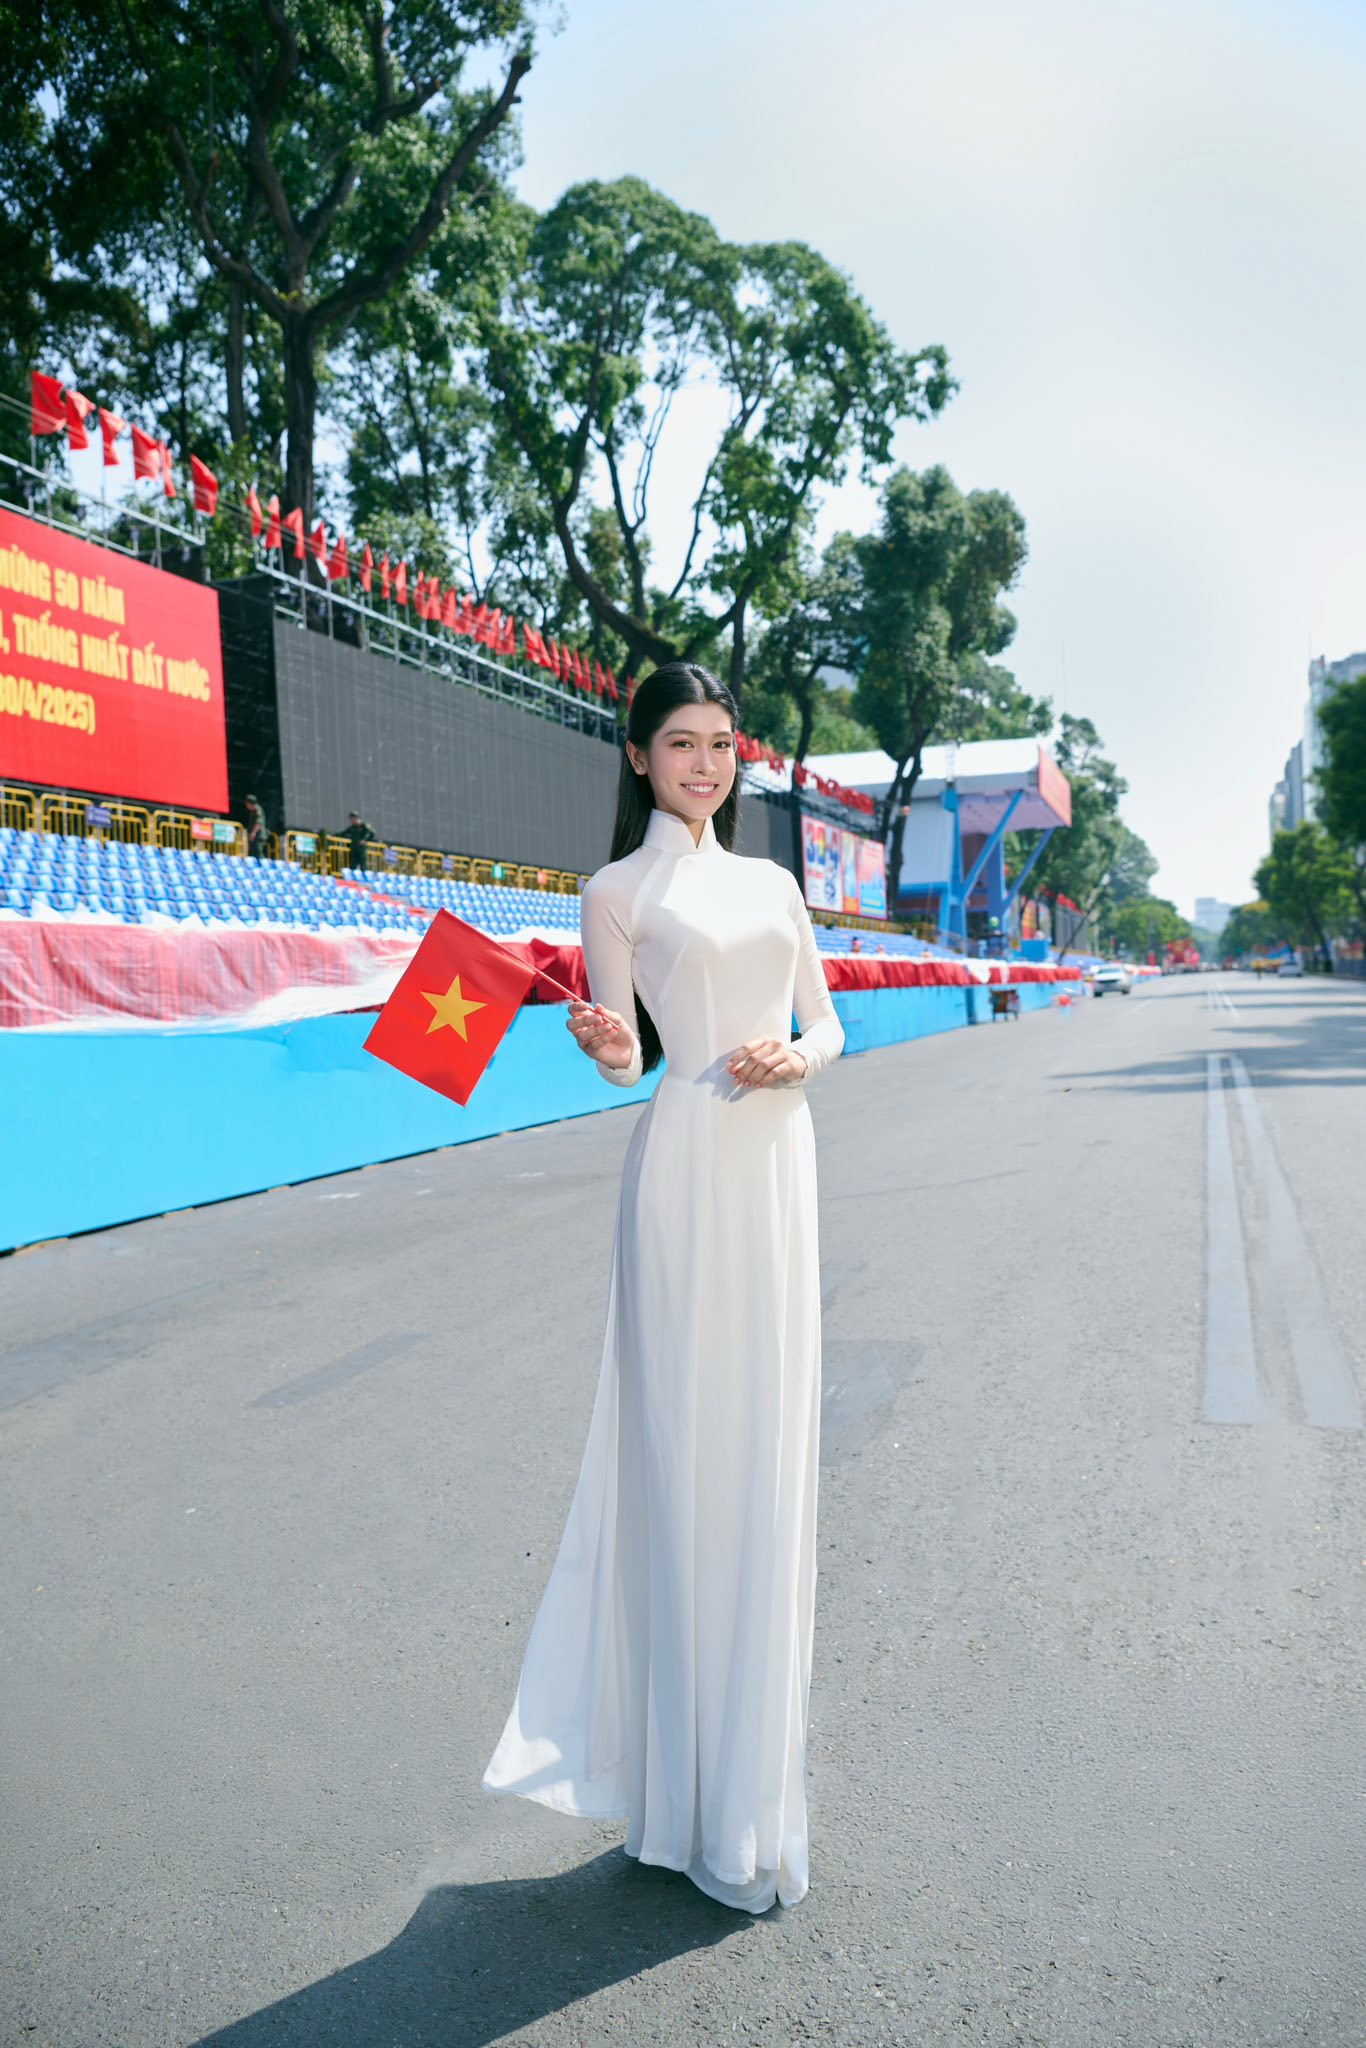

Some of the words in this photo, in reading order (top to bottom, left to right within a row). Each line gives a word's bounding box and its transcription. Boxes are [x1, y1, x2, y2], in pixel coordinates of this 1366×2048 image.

[54, 567, 80, 611] 50
[81, 574, 126, 626] NĂM
[12, 609, 80, 668] THỐNG
[80, 630, 129, 681] NHẤT
[131, 641, 164, 690] ĐẤT
[166, 657, 211, 703] NƯỚC
